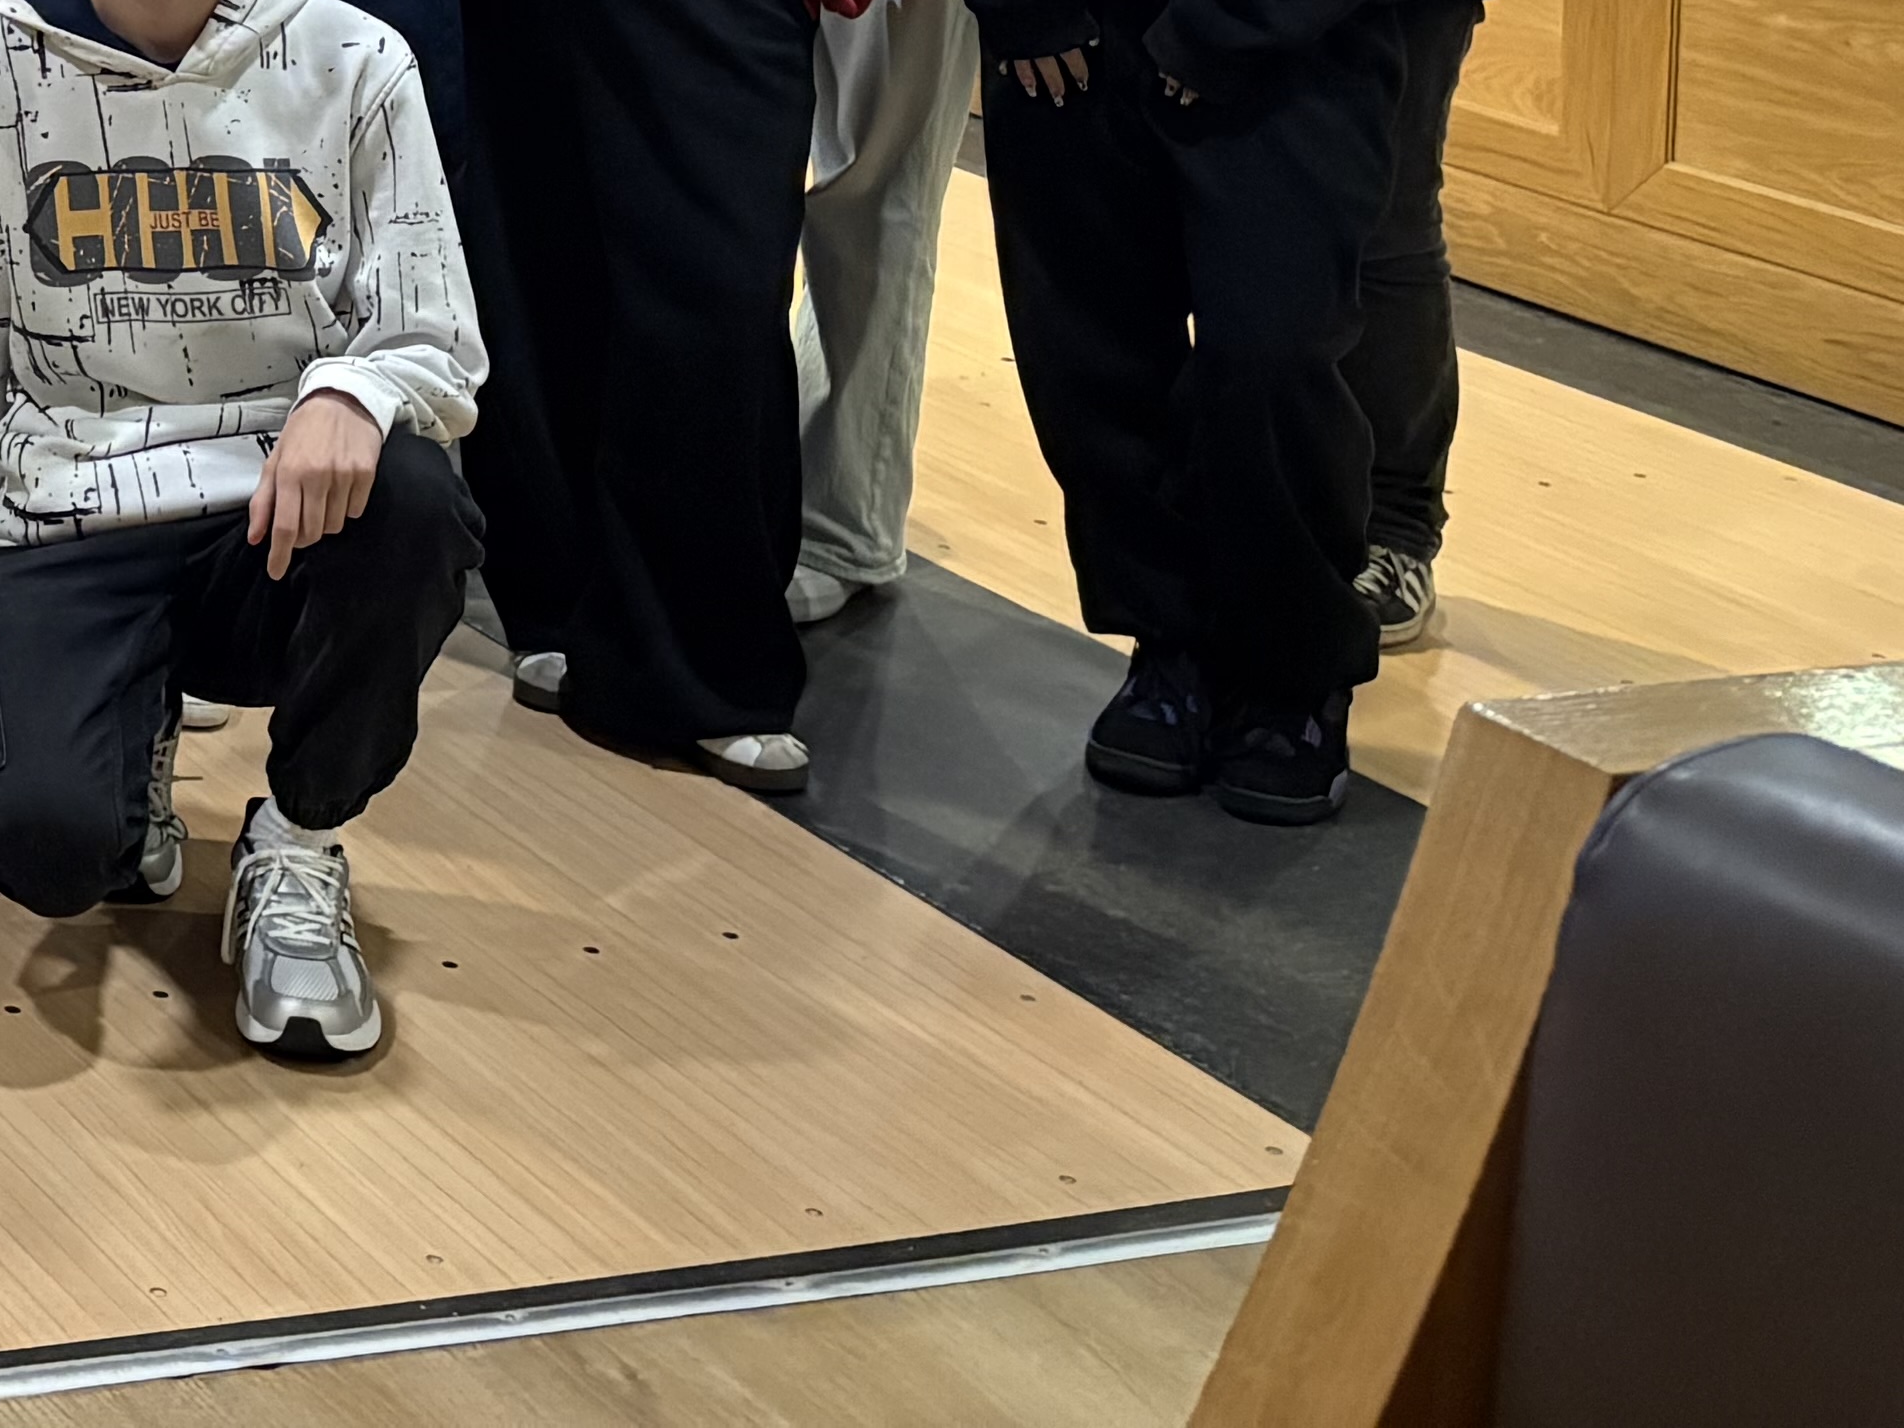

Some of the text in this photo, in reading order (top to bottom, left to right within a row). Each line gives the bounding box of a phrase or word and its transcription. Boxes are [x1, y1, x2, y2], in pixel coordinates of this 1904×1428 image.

[149, 208, 223, 231] JUST BE
[99, 286, 283, 321] NEW YORK CITY
